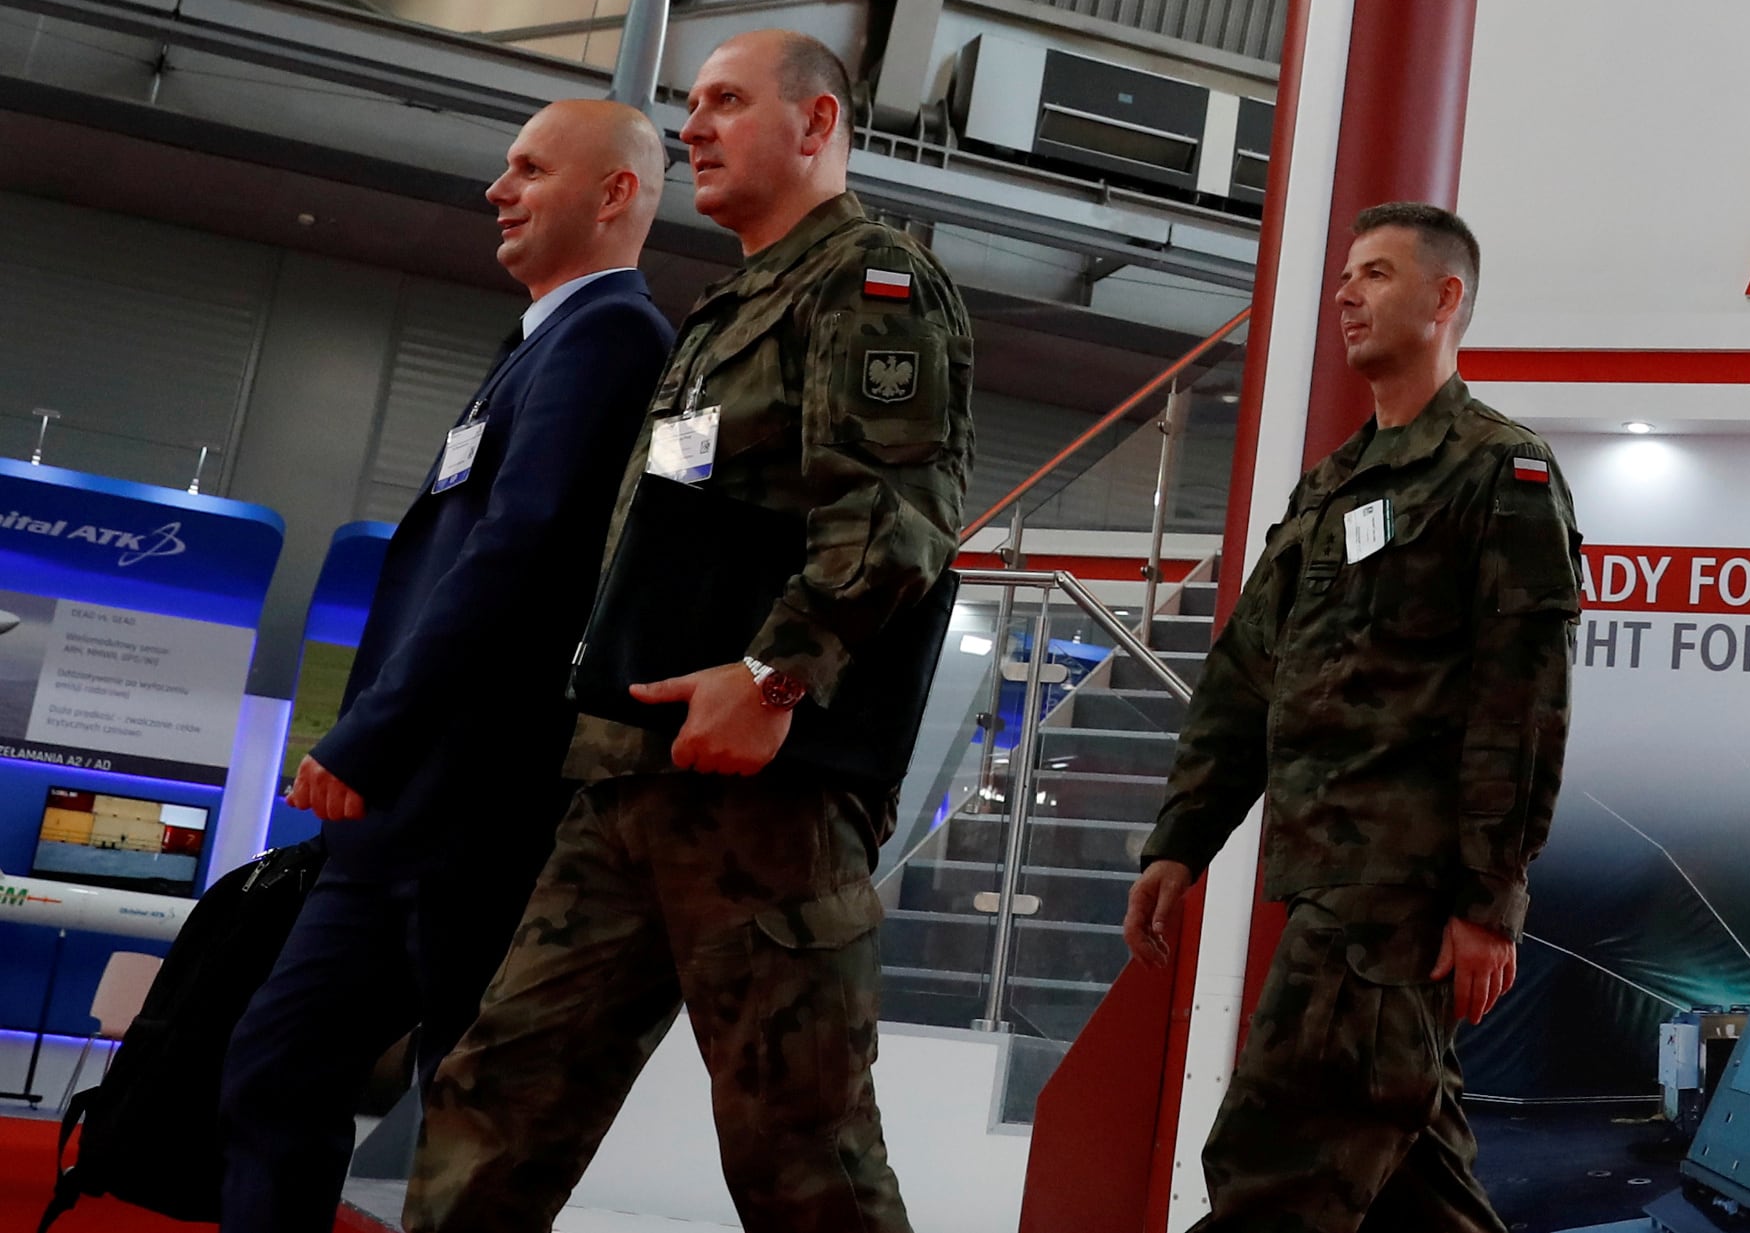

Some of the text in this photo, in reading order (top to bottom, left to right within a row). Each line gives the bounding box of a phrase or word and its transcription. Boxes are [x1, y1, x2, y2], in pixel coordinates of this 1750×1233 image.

[0, 511, 146, 550] ital ATK
[1573, 620, 1651, 668] HT
